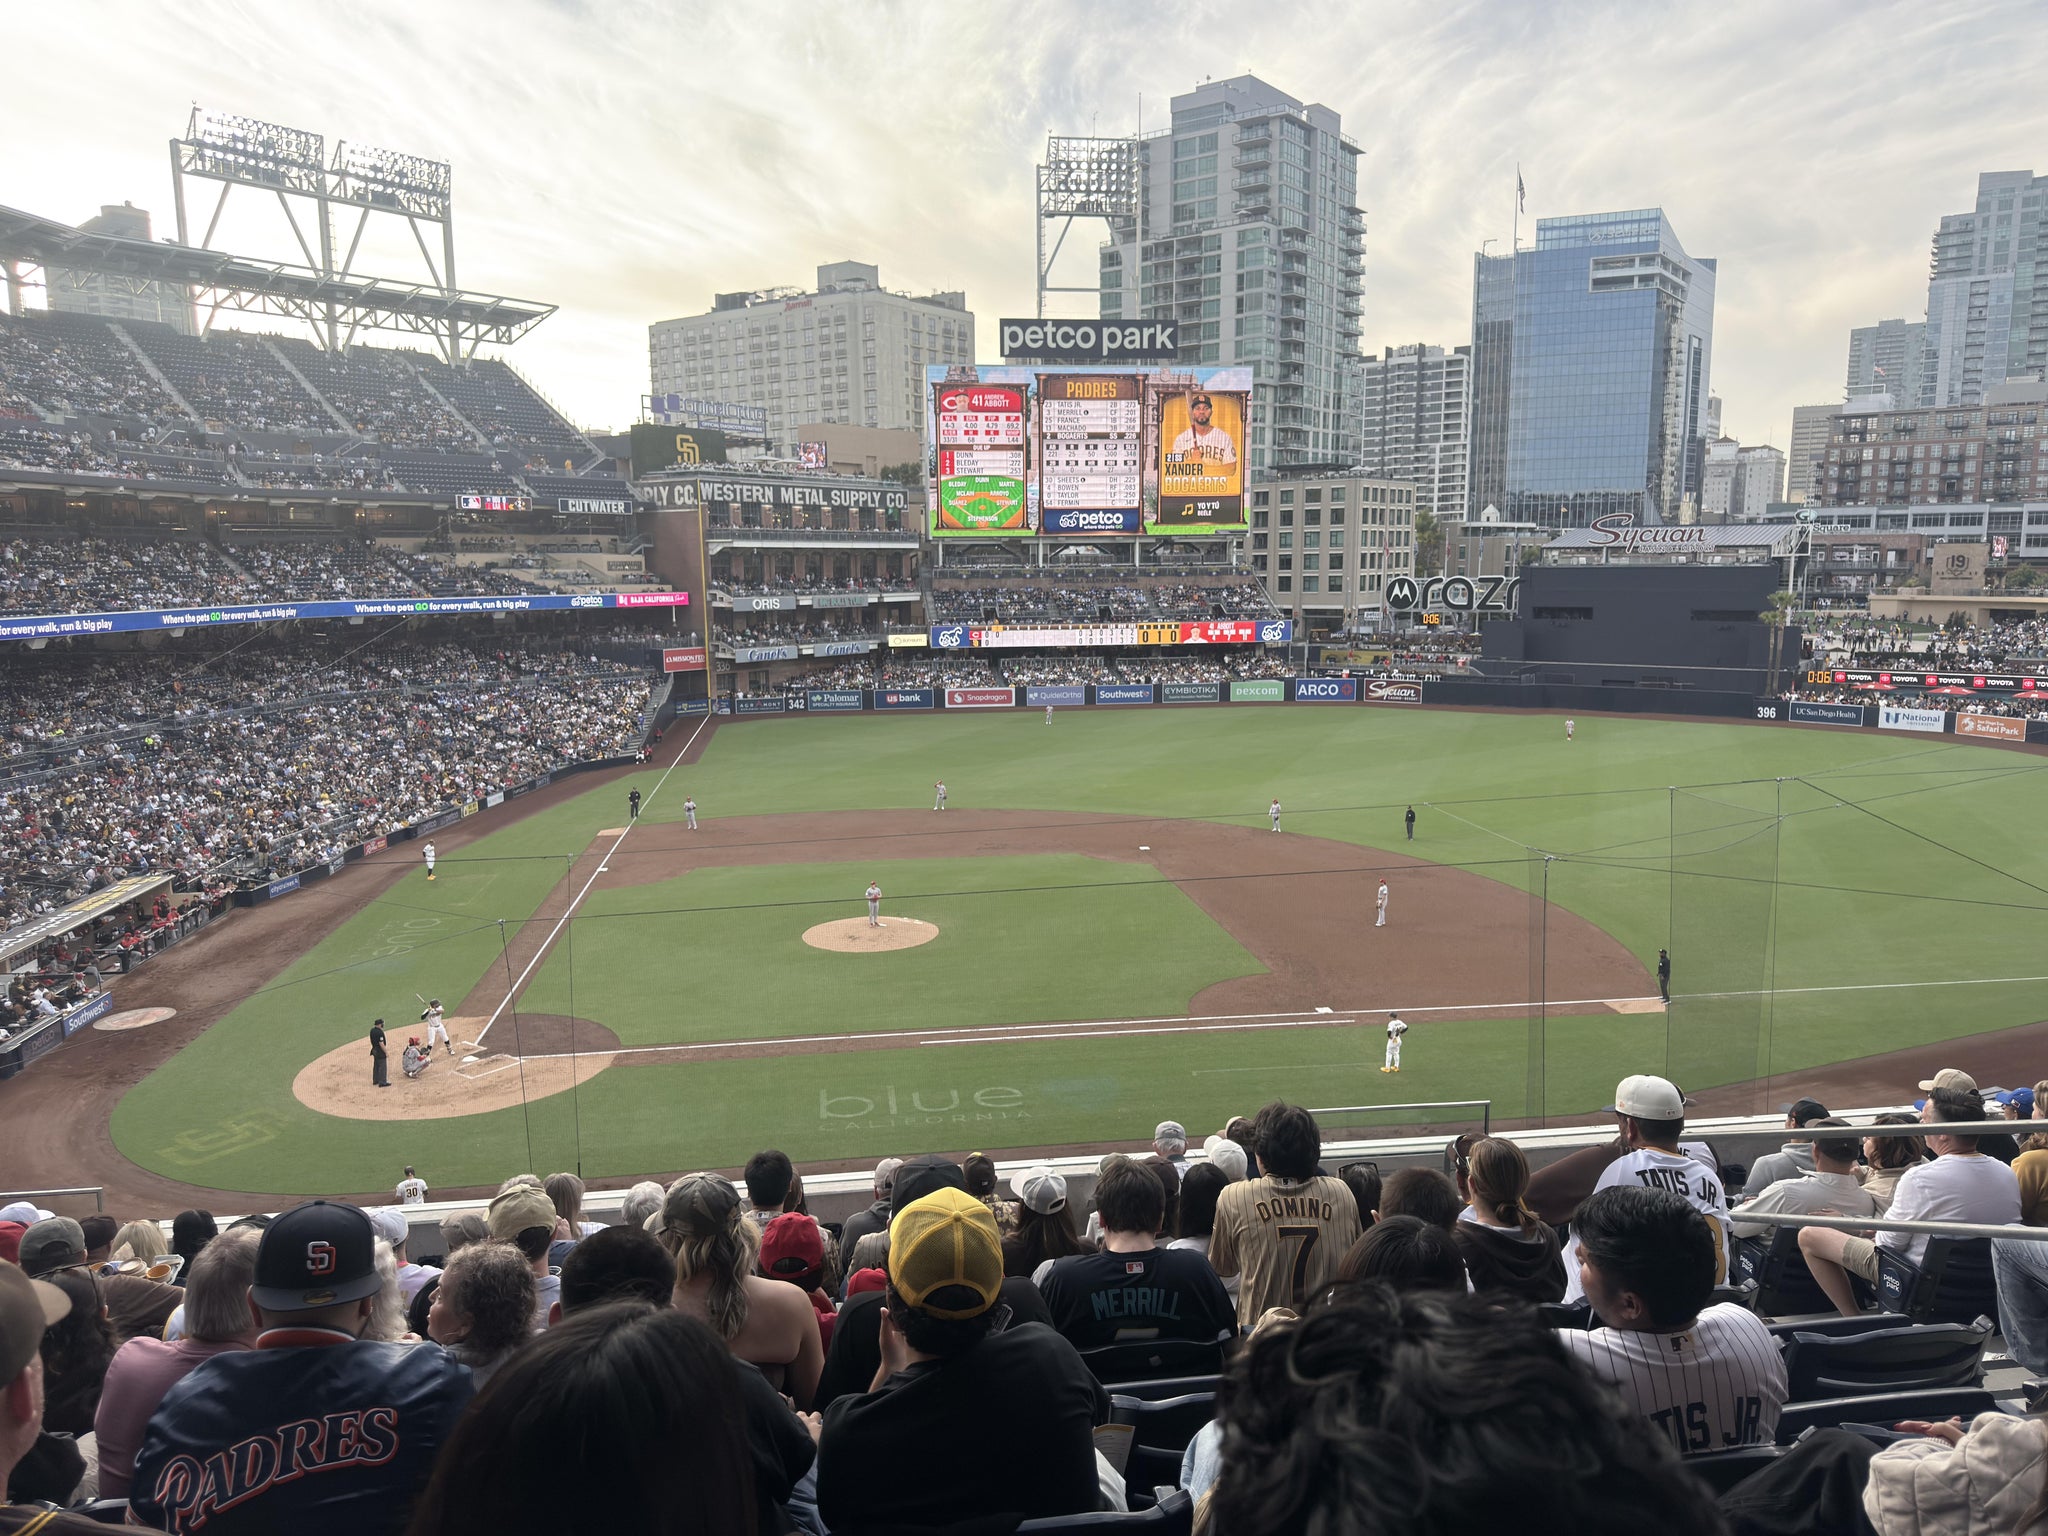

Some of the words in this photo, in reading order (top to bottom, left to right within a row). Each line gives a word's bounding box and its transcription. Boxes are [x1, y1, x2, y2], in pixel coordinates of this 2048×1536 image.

[1004, 321, 1096, 355] petco
[1102, 324, 1174, 356] park
[1067, 382, 1116, 397] PADRES
[972, 395, 982, 406] 41
[1165, 464, 1203, 476] XANDER
[1164, 477, 1227, 492] BOGAERTS
[700, 482, 773, 504] WESTERN
[781, 486, 827, 506] METAL
[831, 489, 881, 508] SUPPLY
[886, 492, 907, 508] CO.
[568, 499, 625, 514] CUTWATER
[1080, 511, 1123, 527] petco
[1588, 512, 1707, 554] Sycuan
[1813, 523, 1850, 533] Square
[1951, 555, 1965, 568] 19
[355, 604, 382, 613] Where
[383, 603, 396, 612] the
[397, 604, 414, 613] pets
[415, 603, 428, 611] GO
[429, 602, 440, 610] for
[441, 603, 462, 612] every
[463, 602, 482, 610] walk,
[502, 600, 514, 609] big
[515, 600, 530, 609] play
[581, 596, 602, 606] petco
[752, 599, 780, 610] ORIS
[162, 614, 184, 624] Where
[185, 613, 195, 623] the
[197, 613, 209, 624] pets
[210, 612, 221, 621] GO
[222, 611, 231, 621] for
[231, 611, 246, 621] every
[263, 610, 271, 618] run
[277, 608, 285, 618] big
[286, 607, 296, 617] play
[1423, 614, 1440, 625] 0:06
[12, 626, 36, 635] every
[37, 622, 59, 633] walk,
[61, 623, 74, 631] run
[76, 621, 82, 630] &
[83, 620, 95, 631] big
[97, 619, 112, 630] play
[1143, 631, 1148, 642] 0
[1171, 631, 1177, 642] 0
[825, 642, 860, 655] Canel's
[748, 649, 787, 662] Canel's
[1808, 671, 1830, 684] 0:06
[1040, 691, 1081, 699] QuidelOrtho
[1100, 690, 1144, 698] Southwest
[1164, 687, 1217, 695] CYMBIOTIKA
[1298, 684, 1339, 696] ARCO
[1368, 681, 1416, 700] Sycuan
[789, 699, 804, 709] 342
[824, 693, 858, 702] Palomar
[967, 694, 1007, 703] Snapdragon
[1757, 707, 1776, 718] 396
[1806, 708, 1818, 716] San
[1819, 708, 1835, 718] Diego
[1836, 709, 1856, 718] Health
[1902, 712, 1940, 722] National
[1977, 724, 1999, 733] Safari
[2001, 726, 2019, 735] Park
[68, 1004, 104, 1031] Southwest
[31, 1029, 54, 1050] petco
[819, 1084, 1024, 1120] blue
[819, 1111, 1033, 1131] CALIFORNIA
[406, 1188, 417, 1197] 30
[1635, 1168, 1690, 1196] TATIS
[1696, 1177, 1719, 1209] JR.
[1256, 1198, 1332, 1223] DOMINO
[1277, 1225, 1320, 1304] 7
[1740, 1255, 1753, 1268] petco
[1742, 1262, 1752, 1273] park
[1884, 1274, 1899, 1287] petco
[1887, 1281, 1899, 1292] park
[1090, 1287, 1180, 1321] MERRILL
[1722, 1396, 1761, 1447] JR.
[155, 1408, 399, 1536] PADRES
